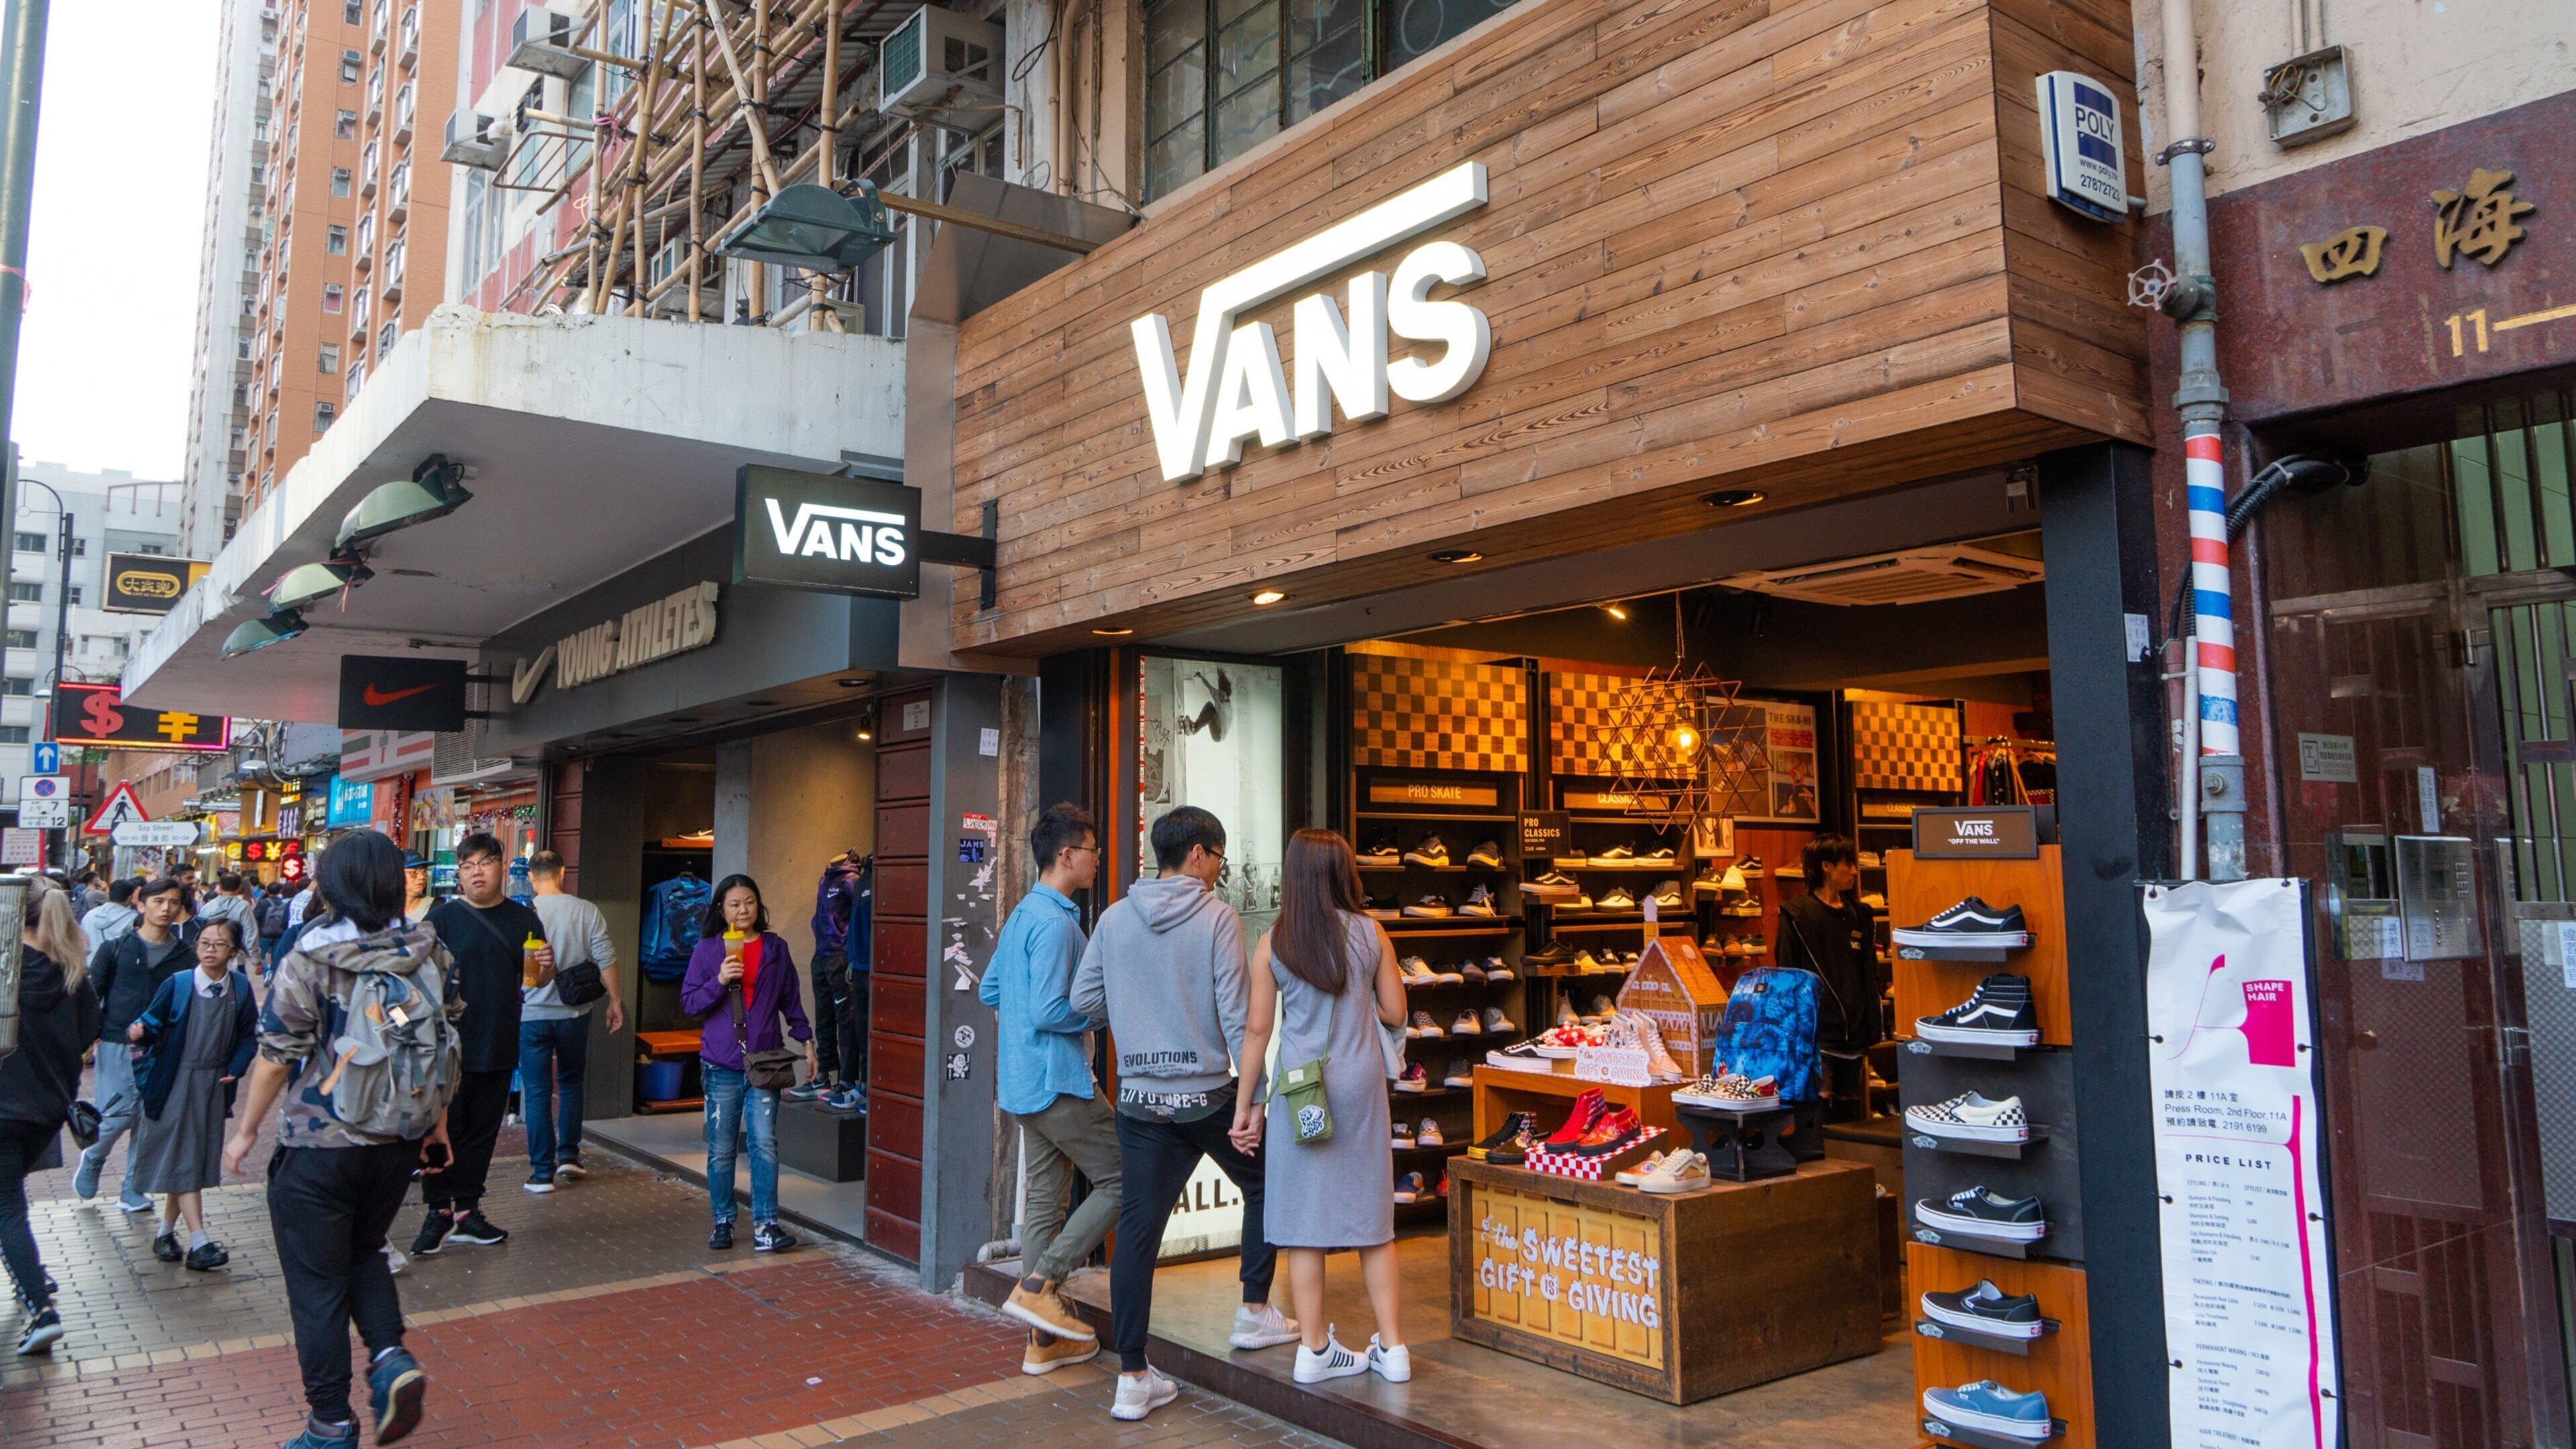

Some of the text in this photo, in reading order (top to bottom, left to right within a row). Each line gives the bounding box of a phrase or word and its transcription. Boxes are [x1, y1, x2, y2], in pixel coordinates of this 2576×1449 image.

[2075, 106, 2114, 142] POLY
[2081, 174, 2120, 201] 27872723
[1131, 161, 1490, 482] VANS
[765, 498, 906, 566] VANS
[557, 580, 718, 689] YOUNG ATHLETES
[1768, 712, 1811, 724] THE SK8-HI
[1408, 785, 1461, 800] PRO SKATE
[51, 817, 65, 826] 12
[1524, 818, 1539, 827] PRO
[1954, 820, 1994, 836] VANS
[1524, 828, 1560, 837] CLASSICS
[2246, 982, 2284, 991] SHAPE
[2248, 992, 2276, 1002] HAIR
[1124, 1051, 1197, 1067] EVOLUTIONS
[2165, 1089, 2238, 1102] 請按 2 樓 11A 室
[2165, 1104, 2191, 1113] Press
[2194, 1105, 2224, 1116] Room,
[2227, 1108, 2242, 1116] 2nd
[2222, 1121, 2244, 1130] 2191
[2247, 1123, 2267, 1134] 6199
[2186, 1154, 2271, 1170] PRICE LIST
[2244, 1185, 2262, 1193] STYLIST
[1482, 1218, 1660, 1290] the SWEETEST
[2193, 1278, 2213, 1286] TINTING
[1481, 1257, 1536, 1298] GIFT
[1567, 1279, 1658, 1328] GIVING
[2196, 1343, 2226, 1352] PERMANENT
[2228, 1348, 2247, 1356] WAVING
[2221, 1361, 2237, 1371] Waving
[2213, 1430, 2237, 1441] TREATMENT
